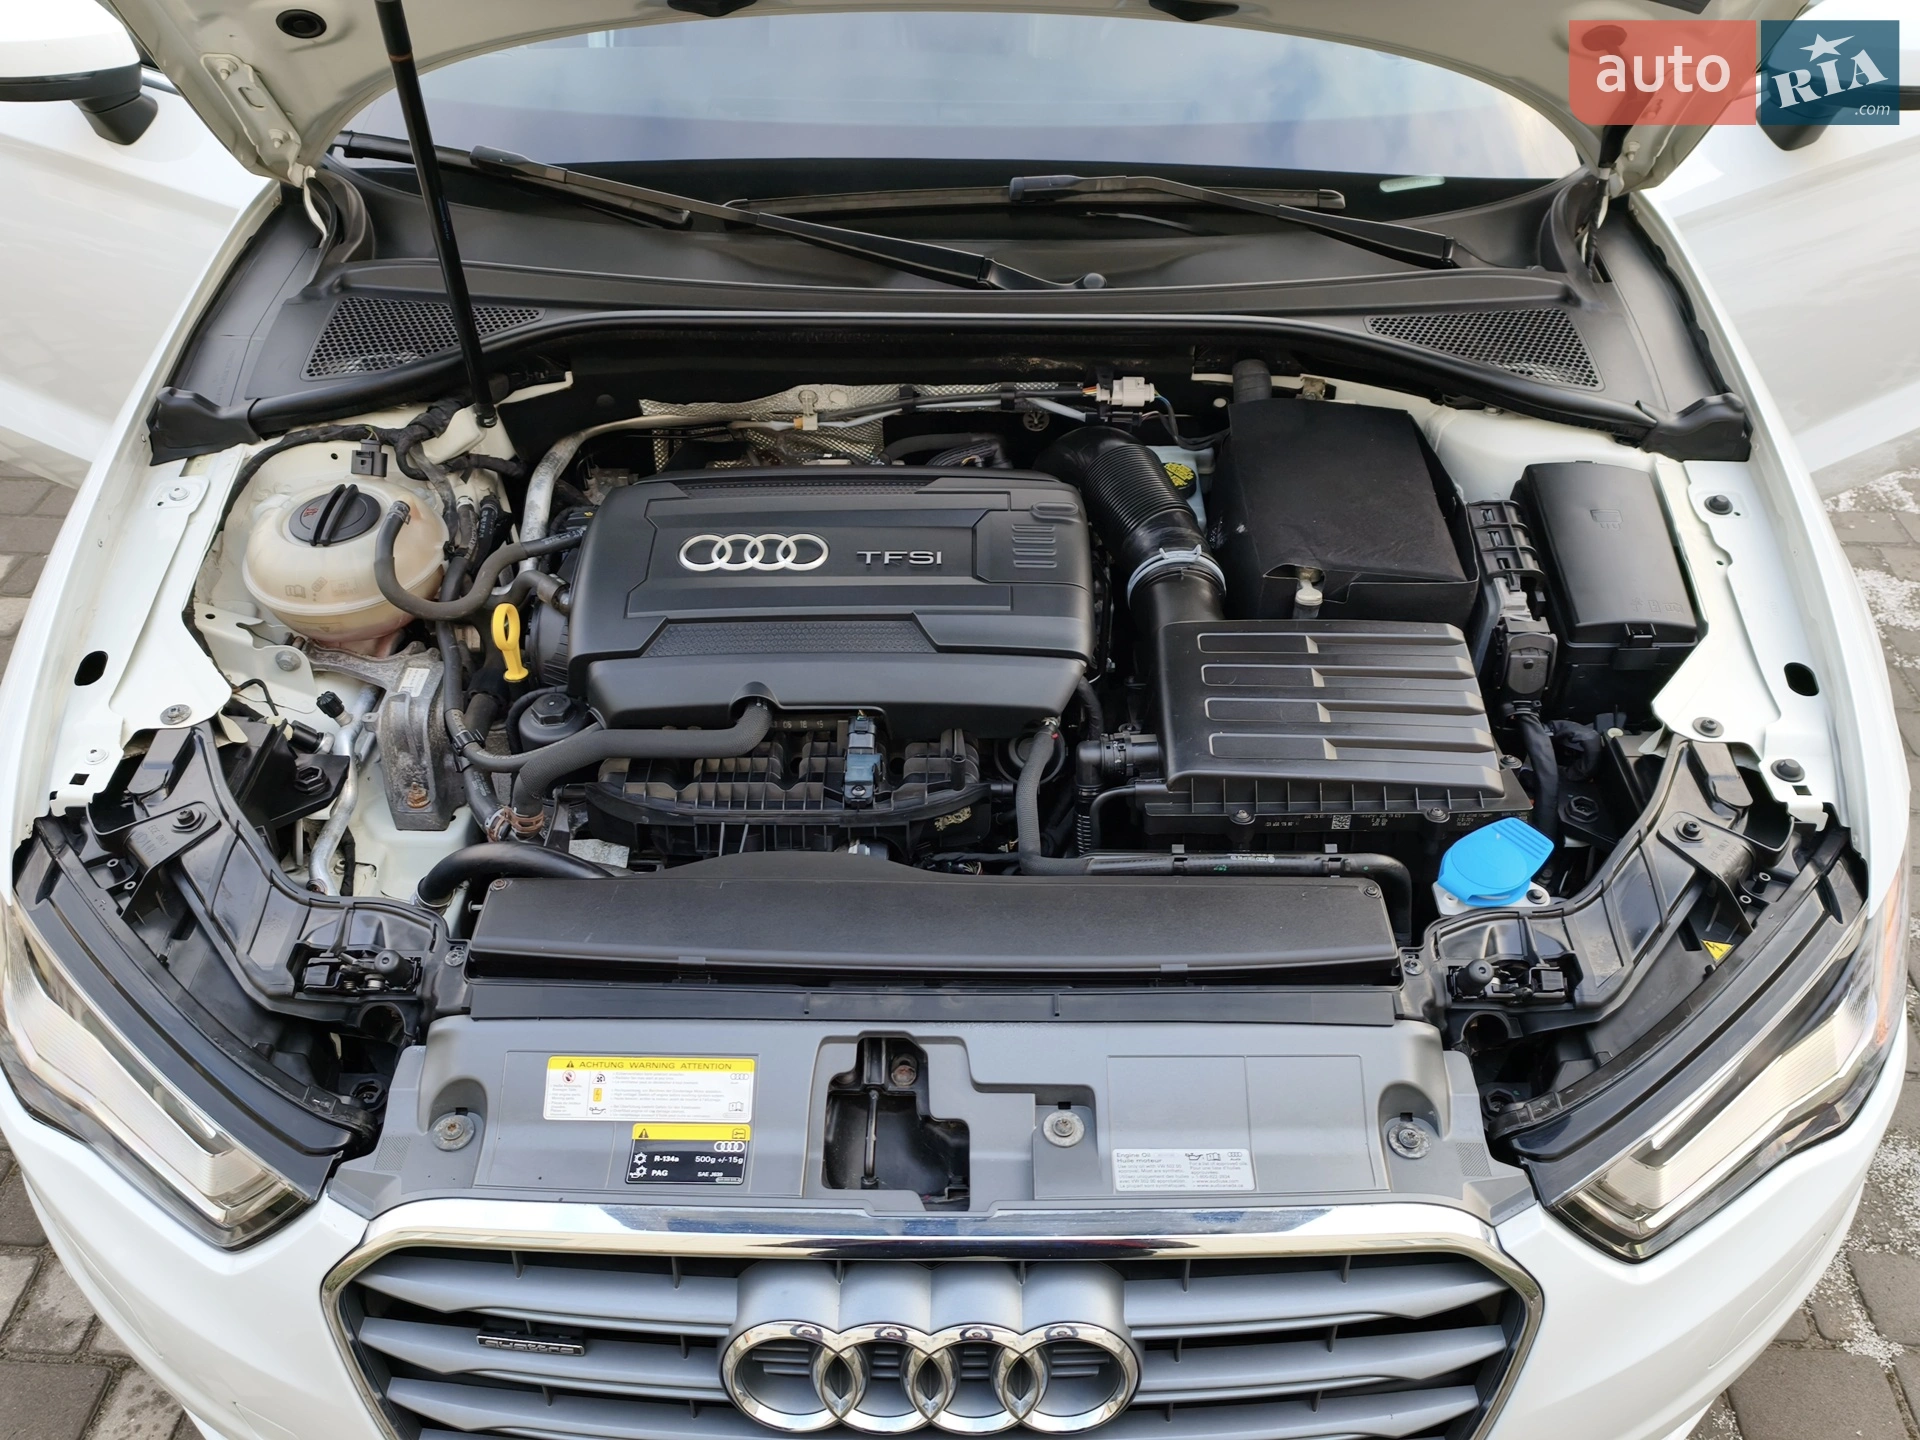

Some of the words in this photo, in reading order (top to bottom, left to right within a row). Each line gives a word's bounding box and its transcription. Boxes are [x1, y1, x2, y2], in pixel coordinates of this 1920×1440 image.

[856, 550, 943, 566] TFSI
[654, 1155, 680, 1163] R-134a
[695, 1156, 716, 1164] 500g
[728, 1156, 744, 1164] 15g
[485, 1340, 575, 1354] quattro
